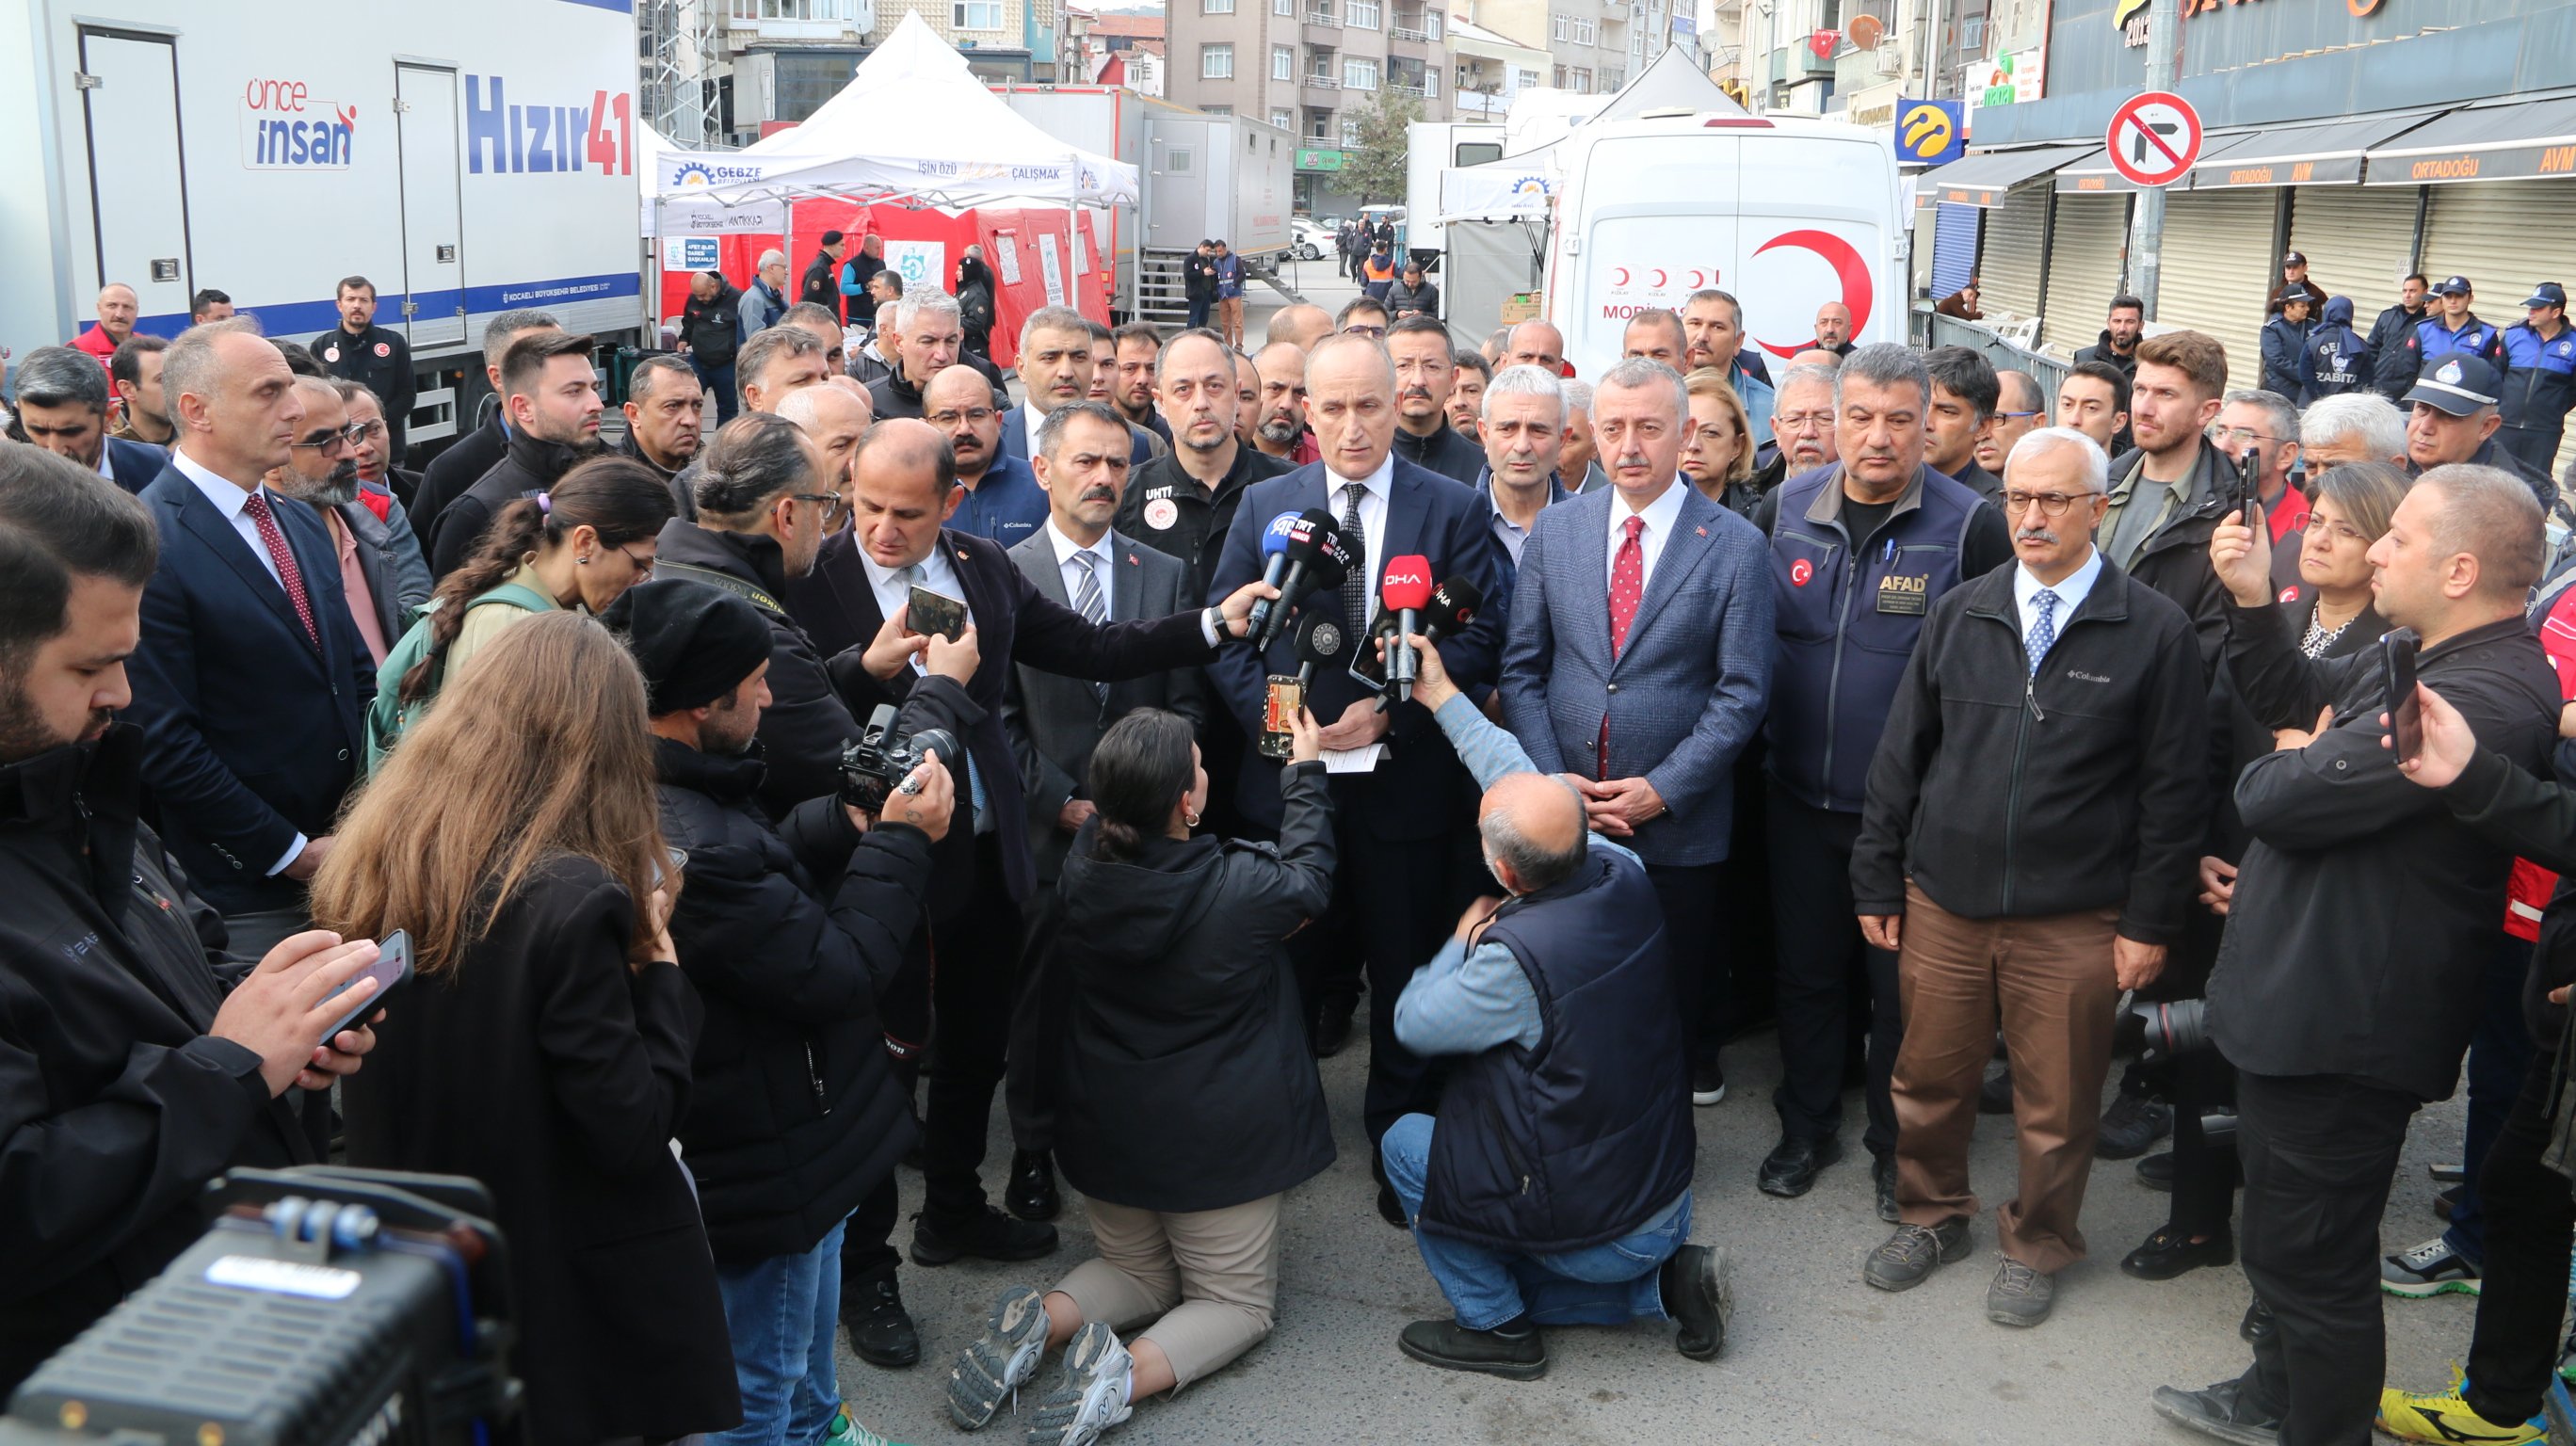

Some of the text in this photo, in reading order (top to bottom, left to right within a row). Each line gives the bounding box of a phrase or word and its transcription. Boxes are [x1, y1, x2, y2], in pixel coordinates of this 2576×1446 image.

[256, 119, 352, 166] insan
[919, 160, 937, 176] İŞİN
[939, 162, 958, 175] ÖZÜ
[1012, 168, 1060, 182] ÇALIŞMAK
[2412, 146, 2576, 180] ORTADOĞU AVM
[716, 167, 762, 179] GEBZE
[2230, 162, 2314, 185] ORTADOĞU AVM
[1295, 519, 1316, 533] TRT
[1385, 574, 1422, 586] DHA
[1879, 575, 1925, 593] AFAD
[2075, 671, 2110, 683] Columbia
